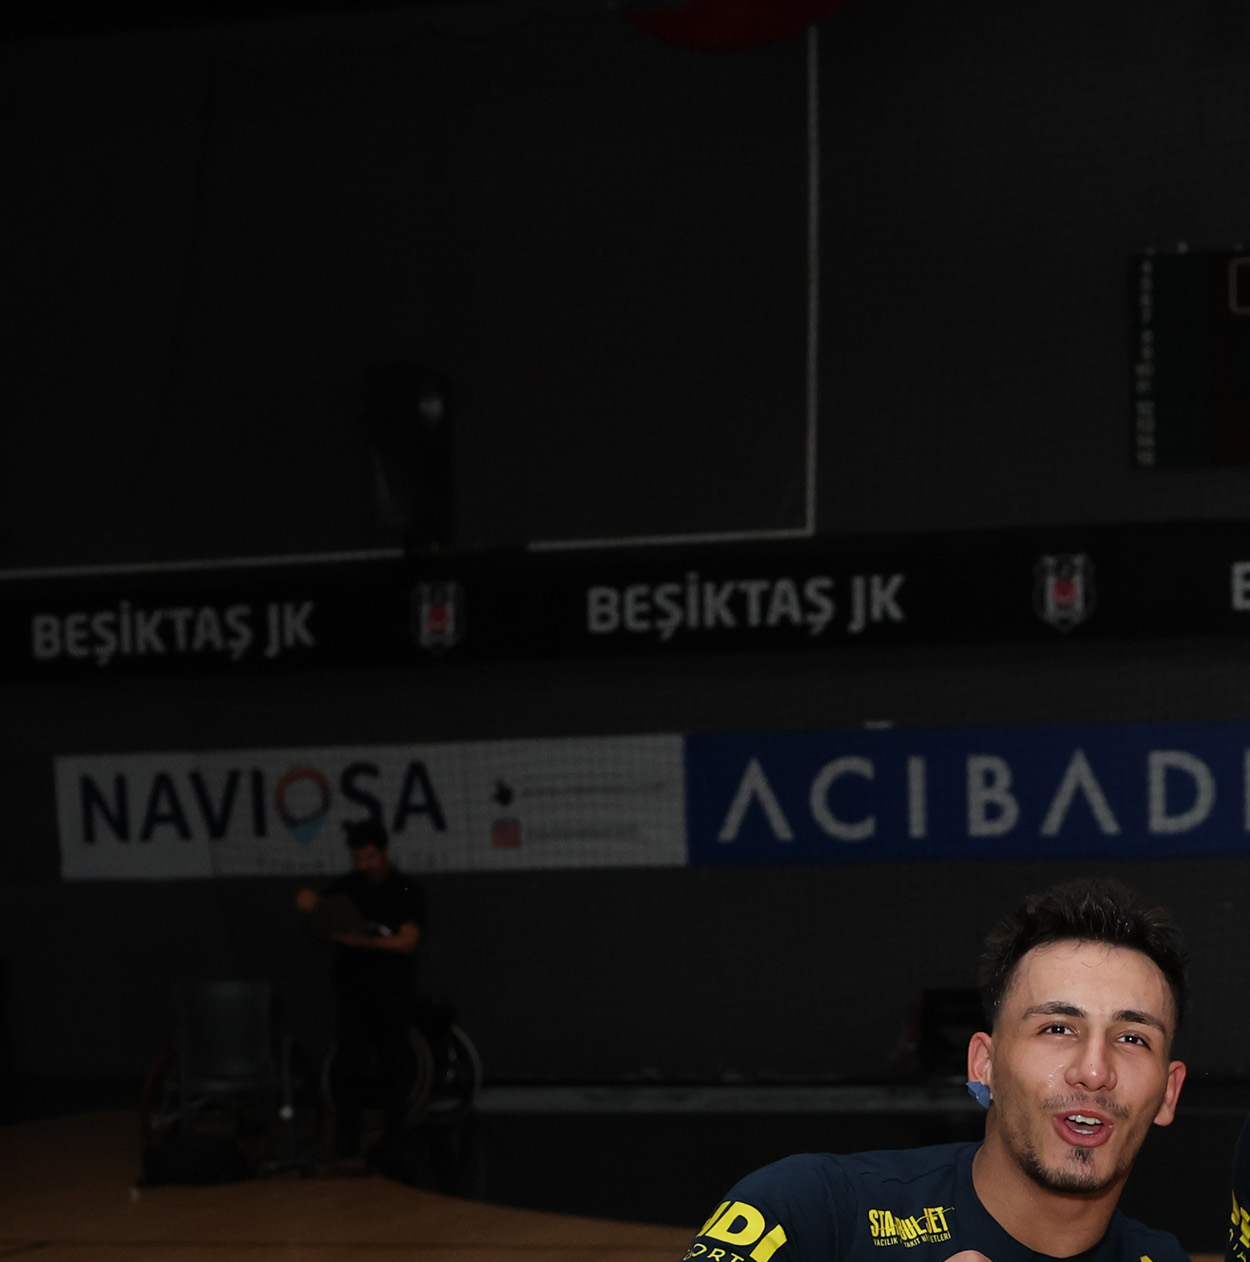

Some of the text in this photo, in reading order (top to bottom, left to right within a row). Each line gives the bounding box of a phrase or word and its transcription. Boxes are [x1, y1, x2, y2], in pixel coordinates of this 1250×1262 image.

[30, 599, 316, 667] BEŞİKTAŞ JK
[586, 571, 906, 642] BEŞİKTAŞ JK
[80, 761, 447, 844] NAVIOSA
